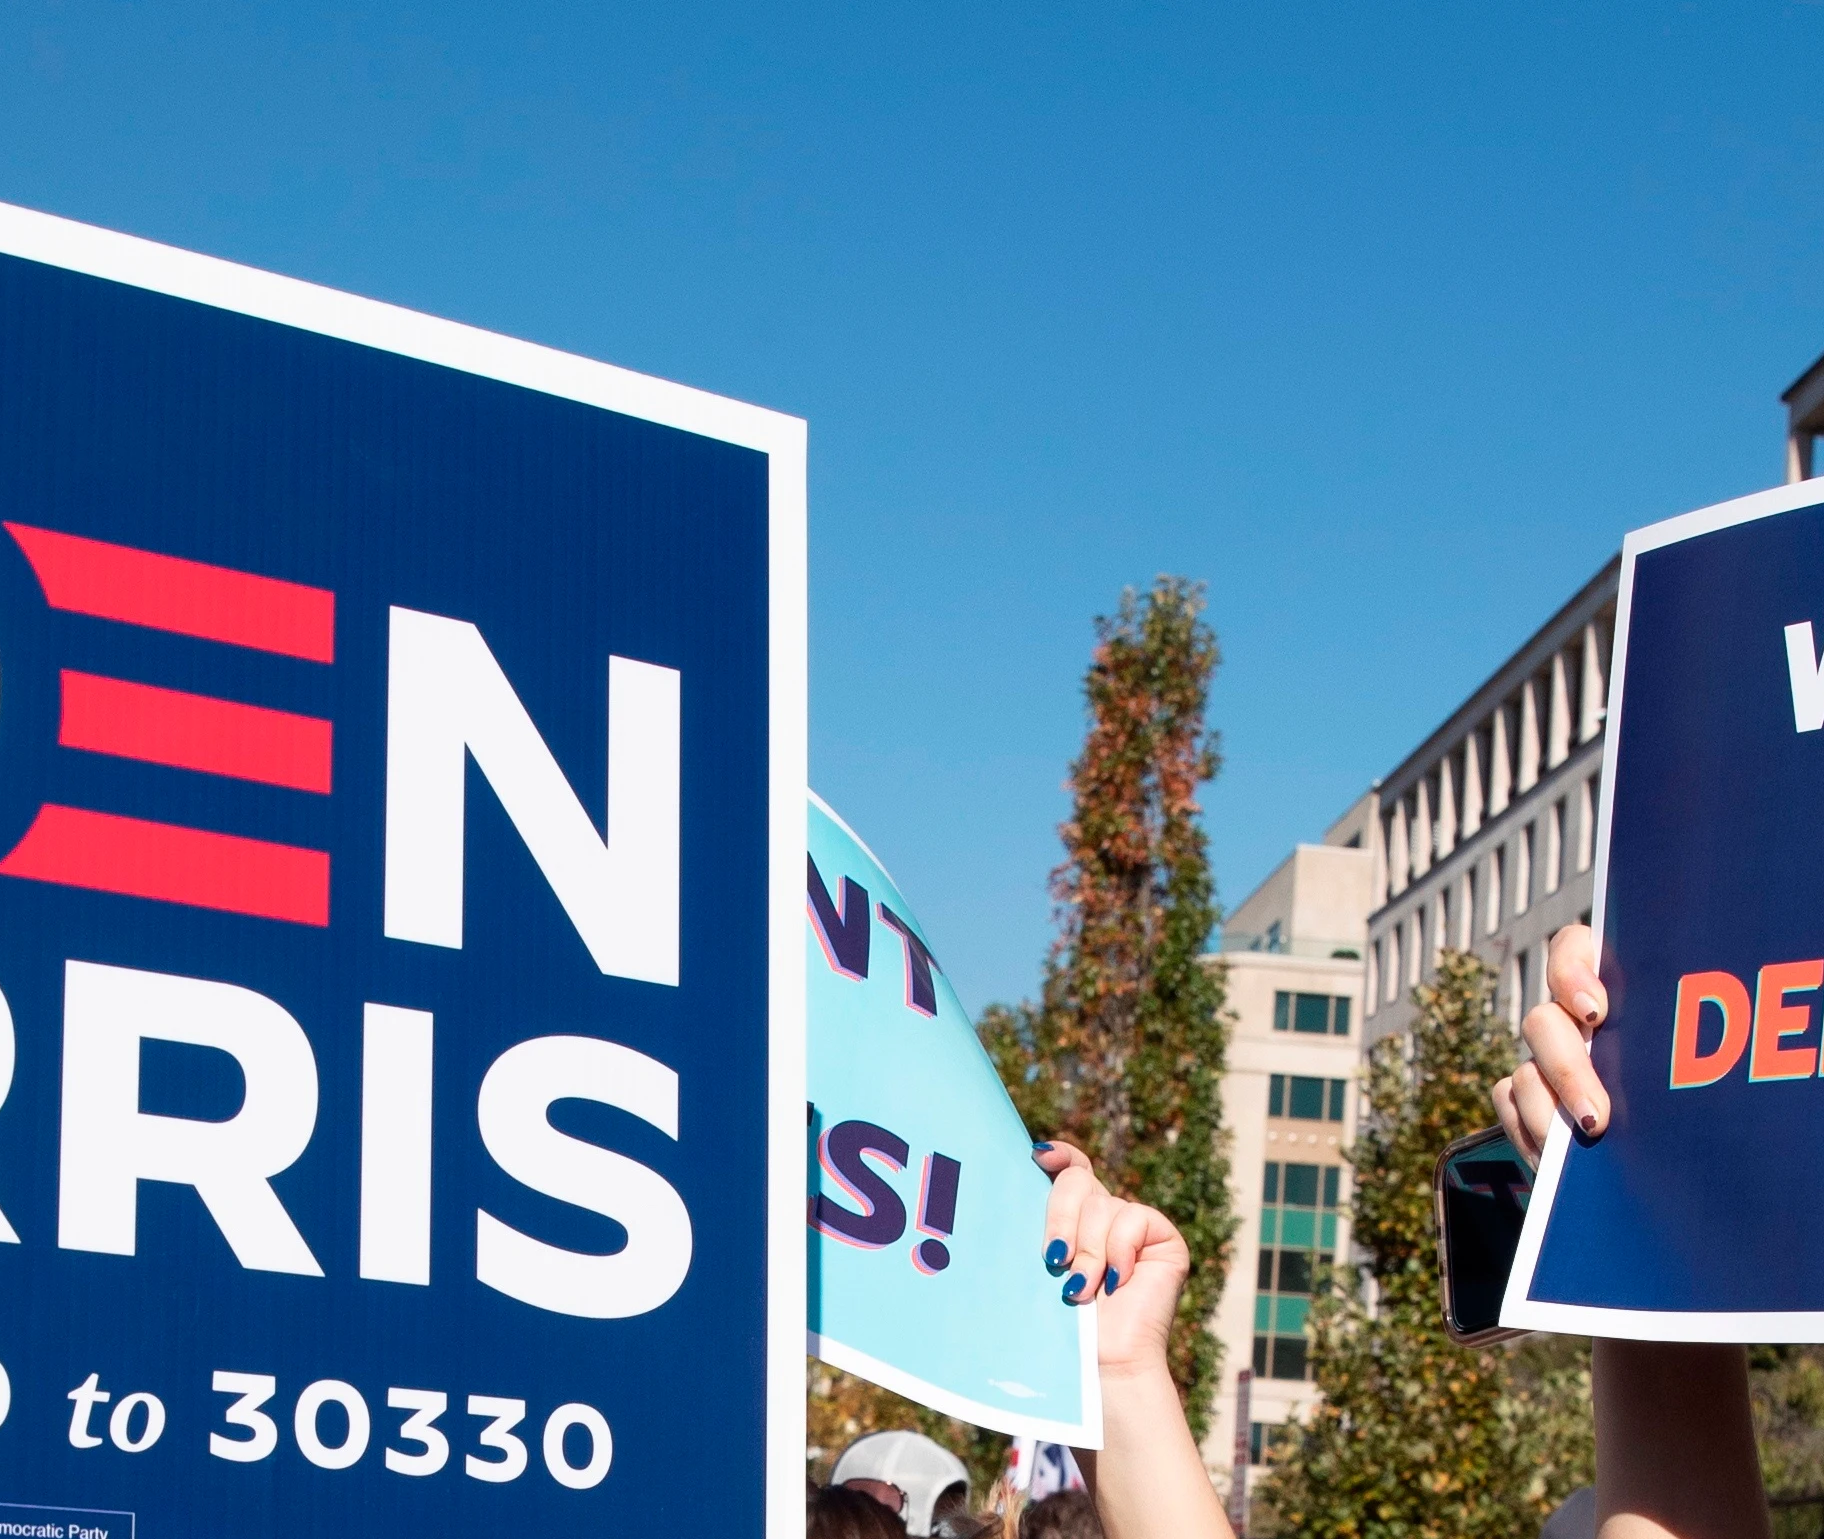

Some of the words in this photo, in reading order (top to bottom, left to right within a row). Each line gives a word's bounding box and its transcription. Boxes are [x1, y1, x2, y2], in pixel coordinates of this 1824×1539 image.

[807, 1102, 962, 1276] S!
[66, 1371, 167, 1453] to
[207, 1368, 615, 1490] 30330
